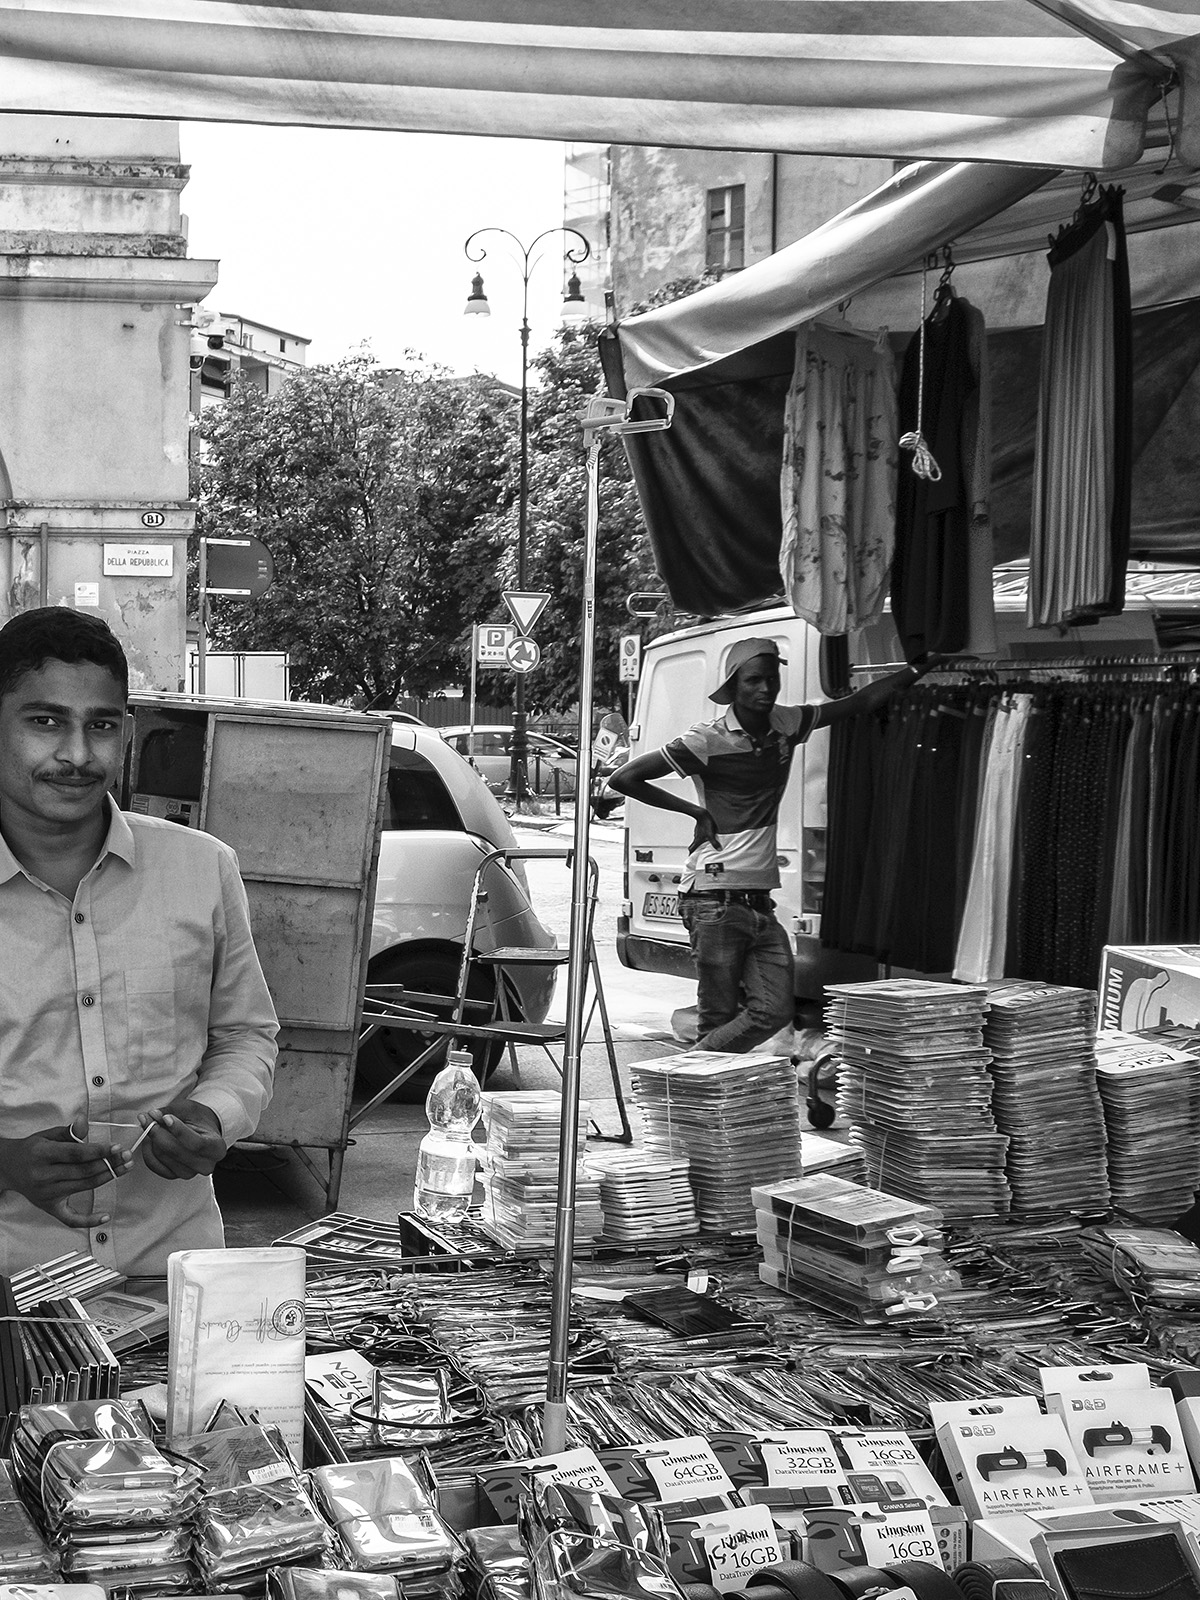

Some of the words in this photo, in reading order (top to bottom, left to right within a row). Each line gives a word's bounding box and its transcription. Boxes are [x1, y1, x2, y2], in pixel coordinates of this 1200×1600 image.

[491, 632, 502, 645] P
[1104, 967, 1124, 1030] MIUM
[1071, 1399, 1106, 1411] D&D
[959, 1424, 996, 1437] D&D
[778, 1444, 828, 1455] Kingston
[857, 1439, 905, 1447] Kingston
[661, 1452, 709, 1467] Kingston
[869, 1450, 916, 1460] 16GB
[786, 1457, 835, 1469] 32GB
[551, 1465, 597, 1481] Kingston
[673, 1463, 719, 1479] 64GB
[721, 1529, 768, 1548] Kingston
[877, 1524, 925, 1539] Kingston
[888, 1540, 935, 1559] 16GB
[107, 1558, 127, 1566] DELLA
[130, 1558, 170, 1567] REPUBBLICA
[731, 1546, 777, 1568] 16GB
